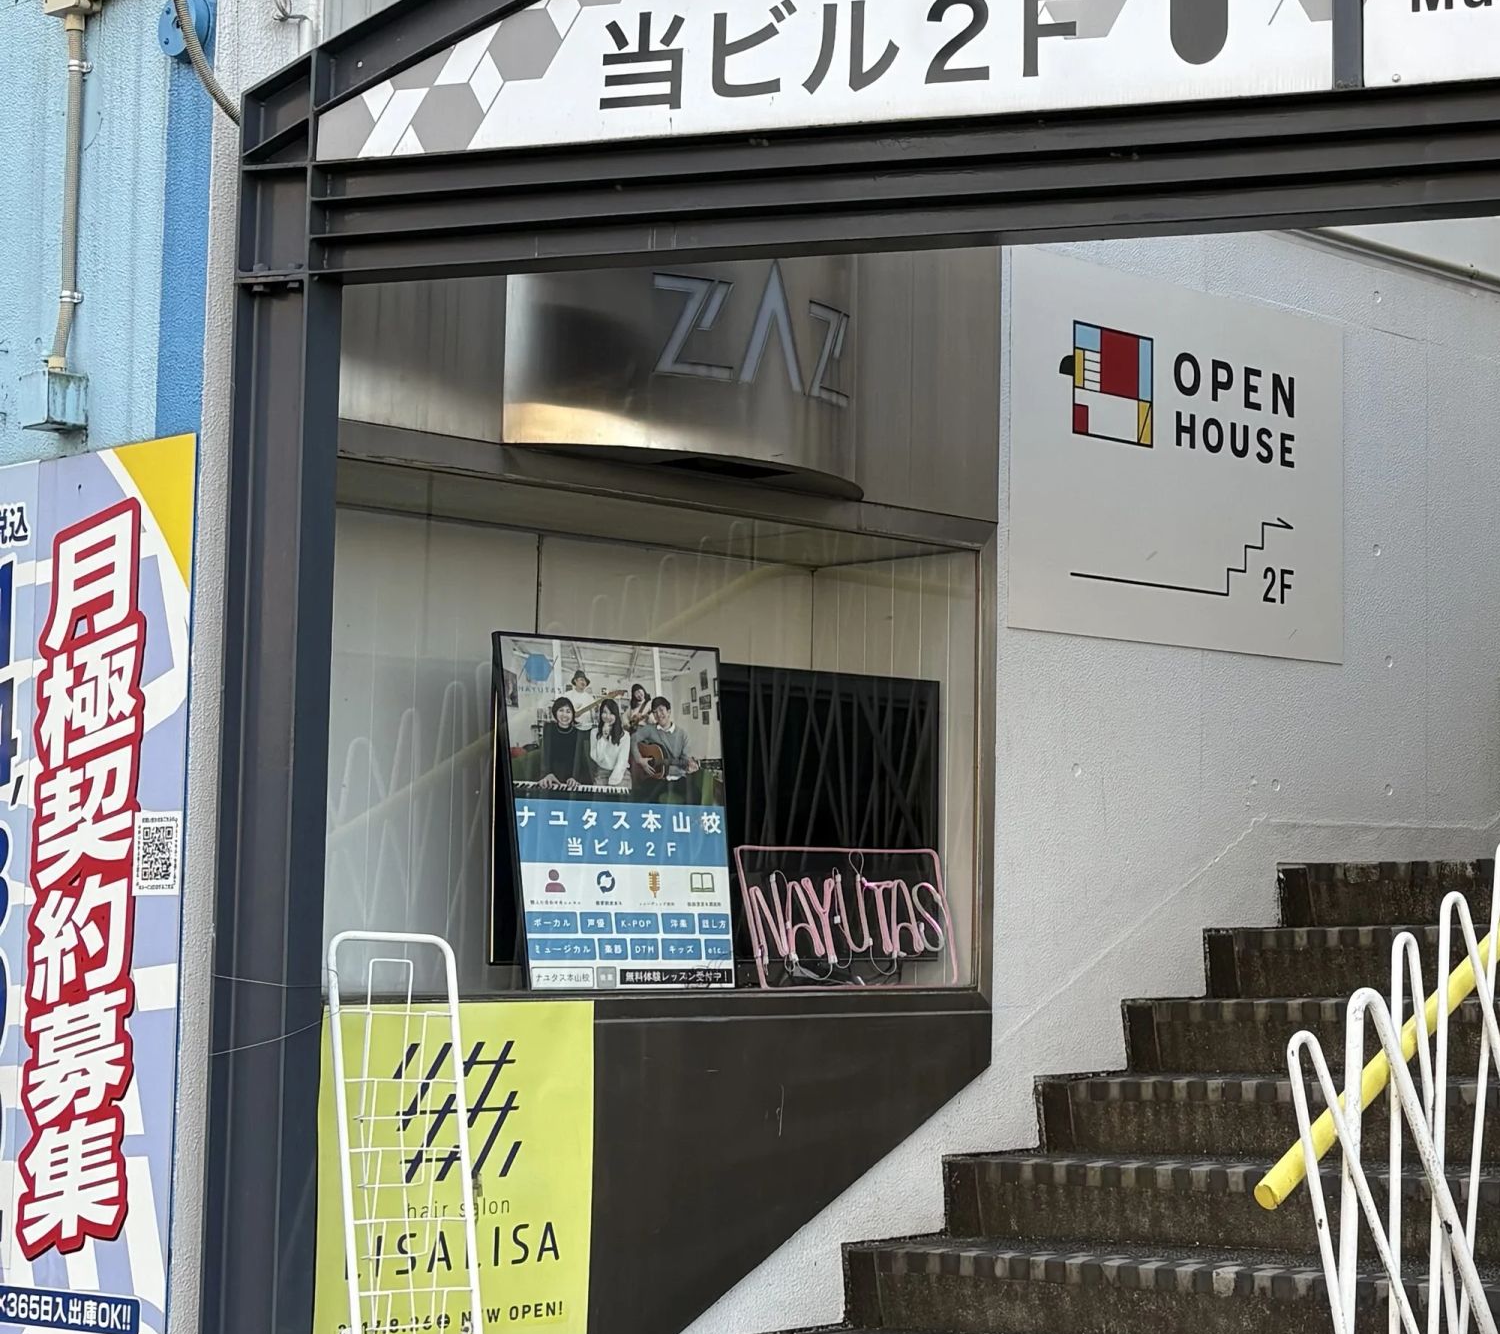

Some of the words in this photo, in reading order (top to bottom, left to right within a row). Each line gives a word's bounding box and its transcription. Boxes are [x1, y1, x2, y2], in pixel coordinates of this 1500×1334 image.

[1173, 352, 1295, 418] OPEN
[1175, 410, 1295, 469] HOUSE
[1262, 566, 1295, 605] 2F
[516, 805, 722, 835] ナユタス本山校
[567, 837, 677, 857] 当ビル2F
[24, 509, 138, 1247] 月極契約募集
[750, 873, 945, 965] NAYUTAS
[345, 1221, 560, 1280] ISAISA
[461, 1307, 500, 1332] NW
[508, 1301, 563, 1323] OPEN!
